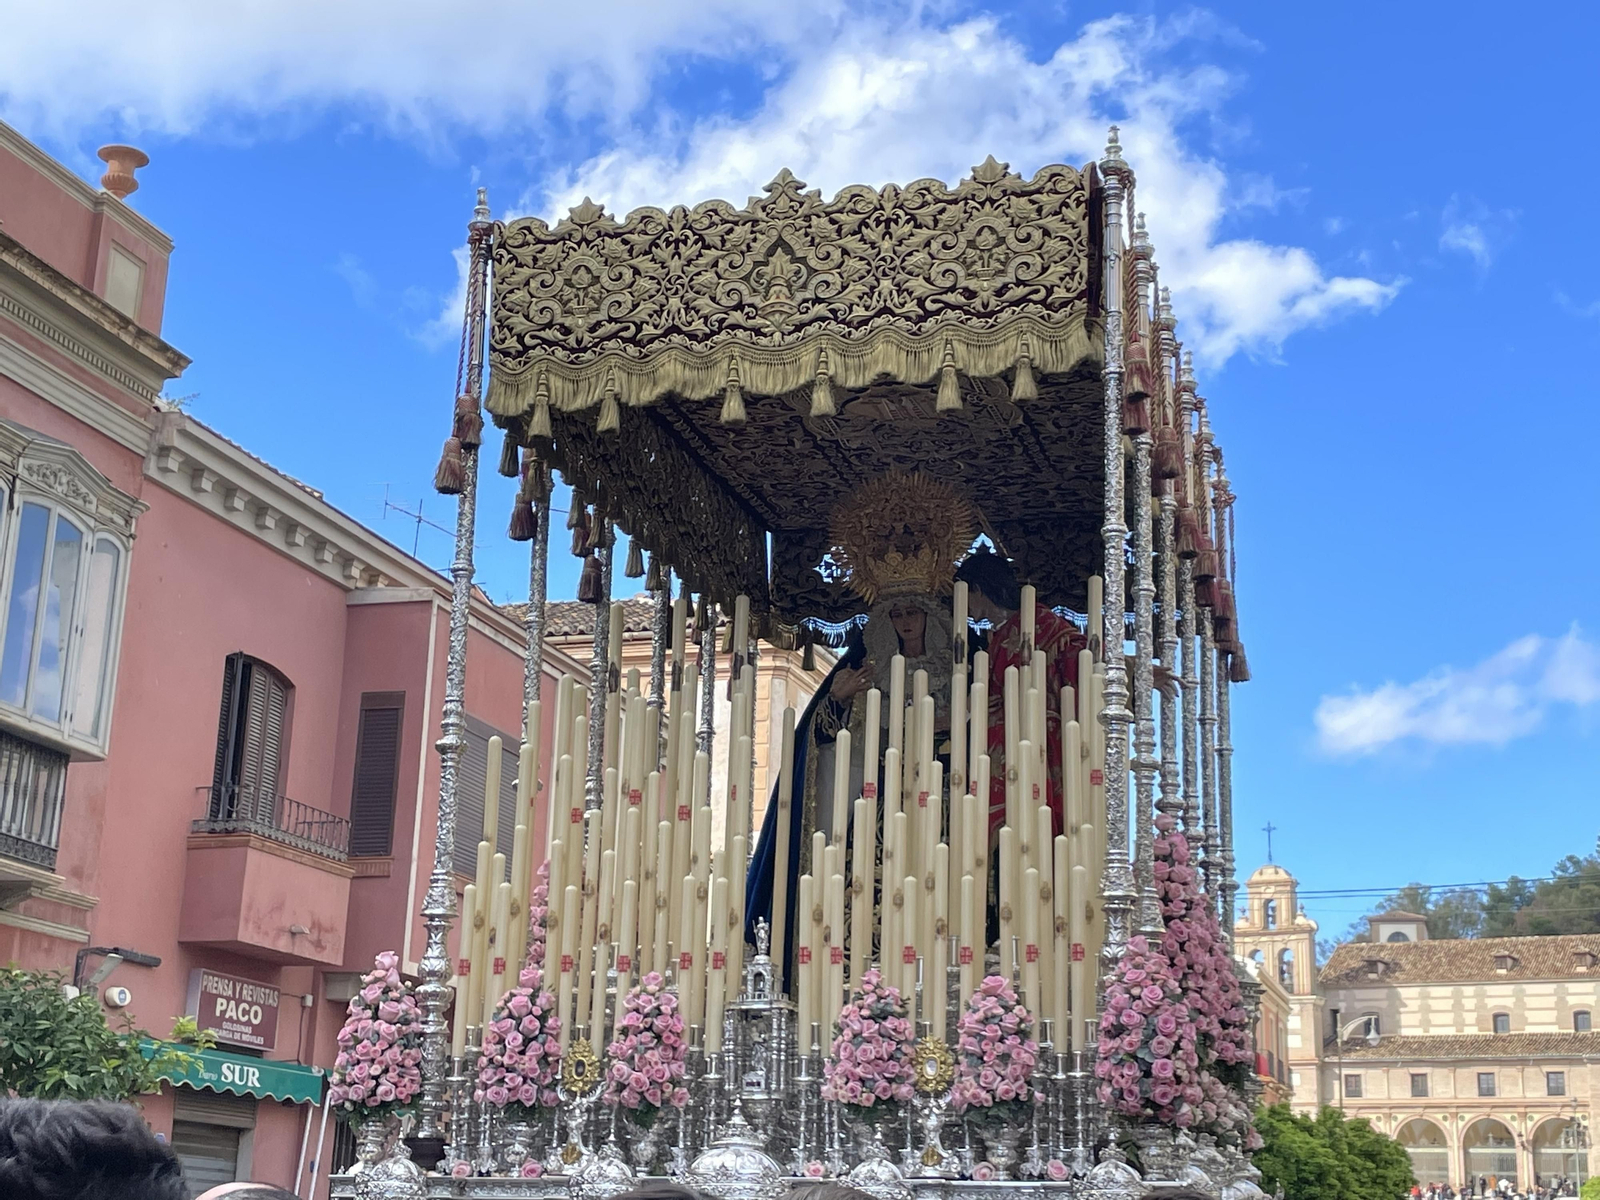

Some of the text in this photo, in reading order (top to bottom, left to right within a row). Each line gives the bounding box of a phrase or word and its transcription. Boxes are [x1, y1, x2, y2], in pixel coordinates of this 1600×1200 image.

[202, 975, 279, 1007] PRENSA Y REVISTAS
[215, 997, 262, 1025] PACO
[222, 1021, 252, 1034] GOLOSINAS
[233, 1031, 241, 1040] DE
[221, 1062, 261, 1087] SUR
